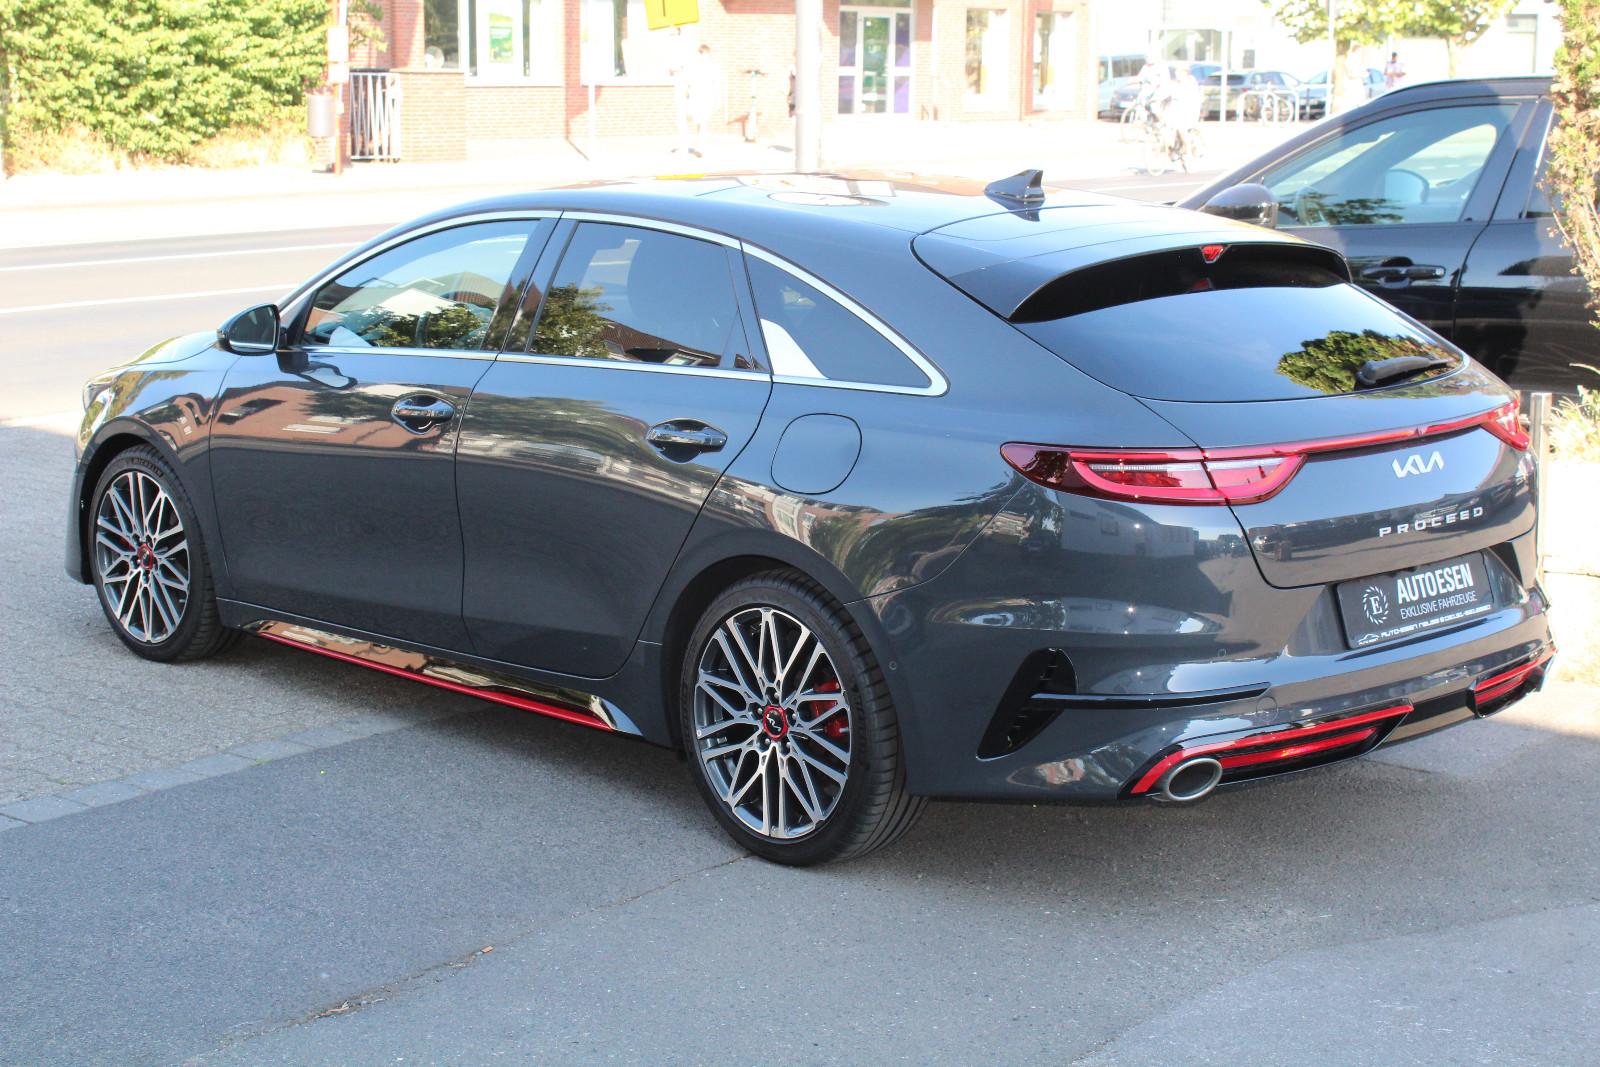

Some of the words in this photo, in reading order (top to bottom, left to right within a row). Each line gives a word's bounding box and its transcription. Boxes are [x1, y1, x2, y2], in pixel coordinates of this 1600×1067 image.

[1391, 451, 1445, 478] KIA
[1379, 506, 1484, 538] PROCEED
[1396, 563, 1474, 604] AUTOESEN
[1369, 595, 1383, 615] E
[1400, 600, 1438, 620] EXKLUSIVE
[1437, 590, 1478, 611] FAHRZEUGE
